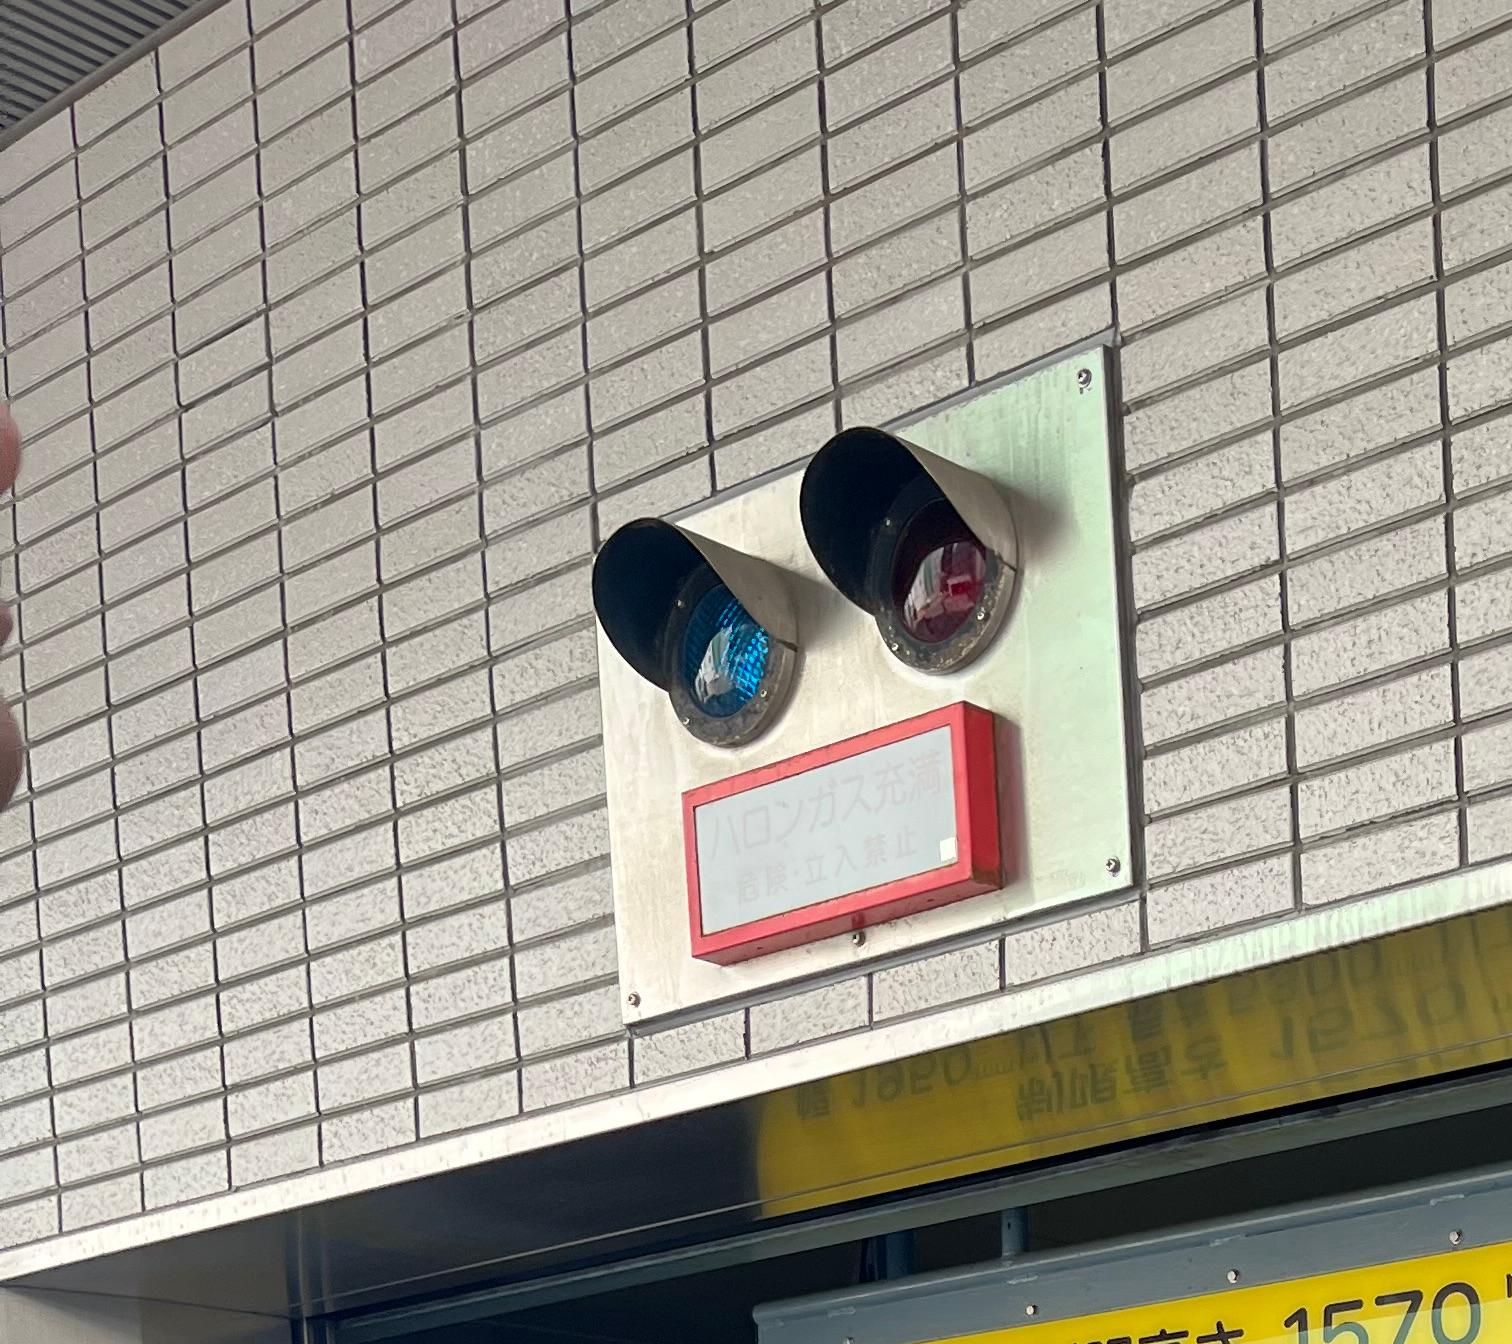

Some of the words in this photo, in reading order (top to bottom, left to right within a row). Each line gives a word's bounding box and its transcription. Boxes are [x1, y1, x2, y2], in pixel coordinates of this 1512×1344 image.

[709, 749, 943, 862] ハロンガス充満
